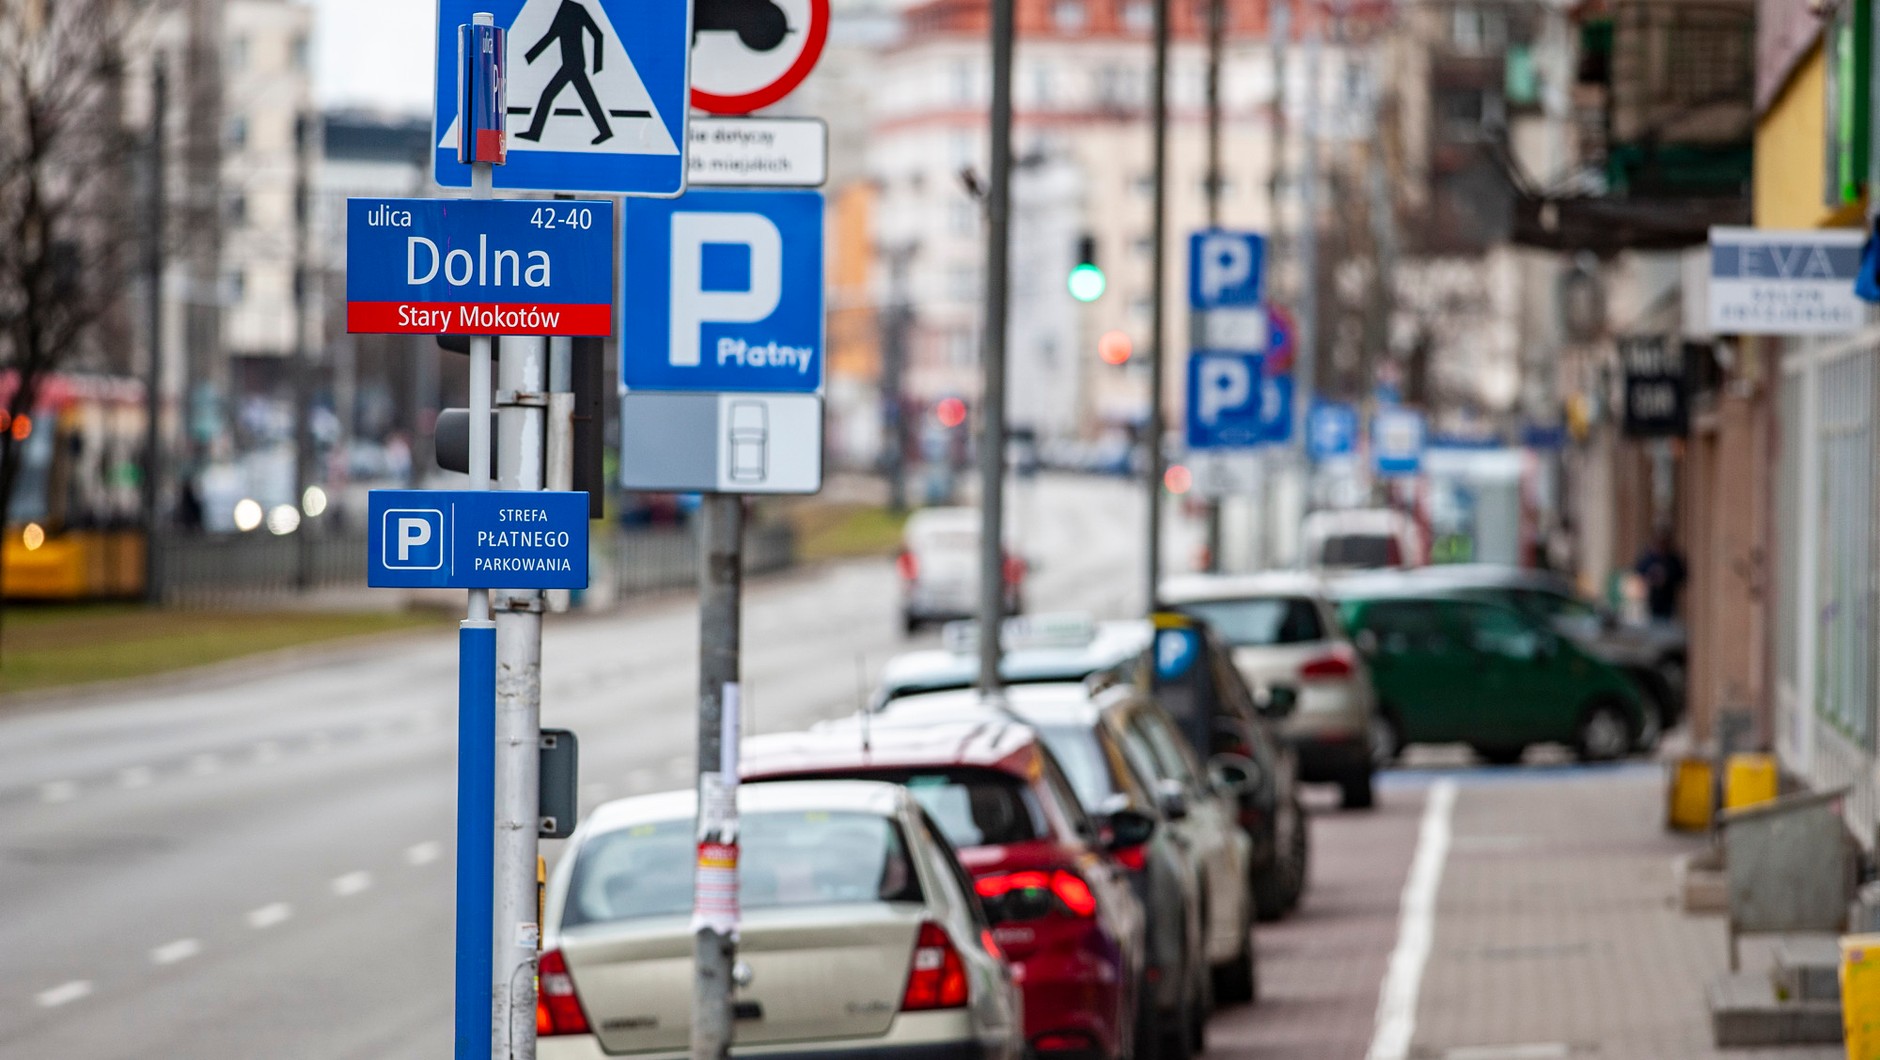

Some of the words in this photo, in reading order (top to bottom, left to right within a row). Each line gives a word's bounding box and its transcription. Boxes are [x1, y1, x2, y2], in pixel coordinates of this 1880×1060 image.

[368, 204, 412, 227] ulica
[530, 208, 592, 230] 42-40
[407, 233, 551, 287] Dolna
[1738, 243, 1836, 279] EVA
[669, 211, 782, 367] P
[398, 305, 452, 332] Stary
[459, 306, 560, 328] Mokotów
[717, 337, 813, 375] Płatny
[499, 509, 548, 522] STREFA
[398, 517, 431, 561] P
[477, 531, 570, 548] PŁATNEGO
[474, 558, 571, 571] PARKOWANIA
